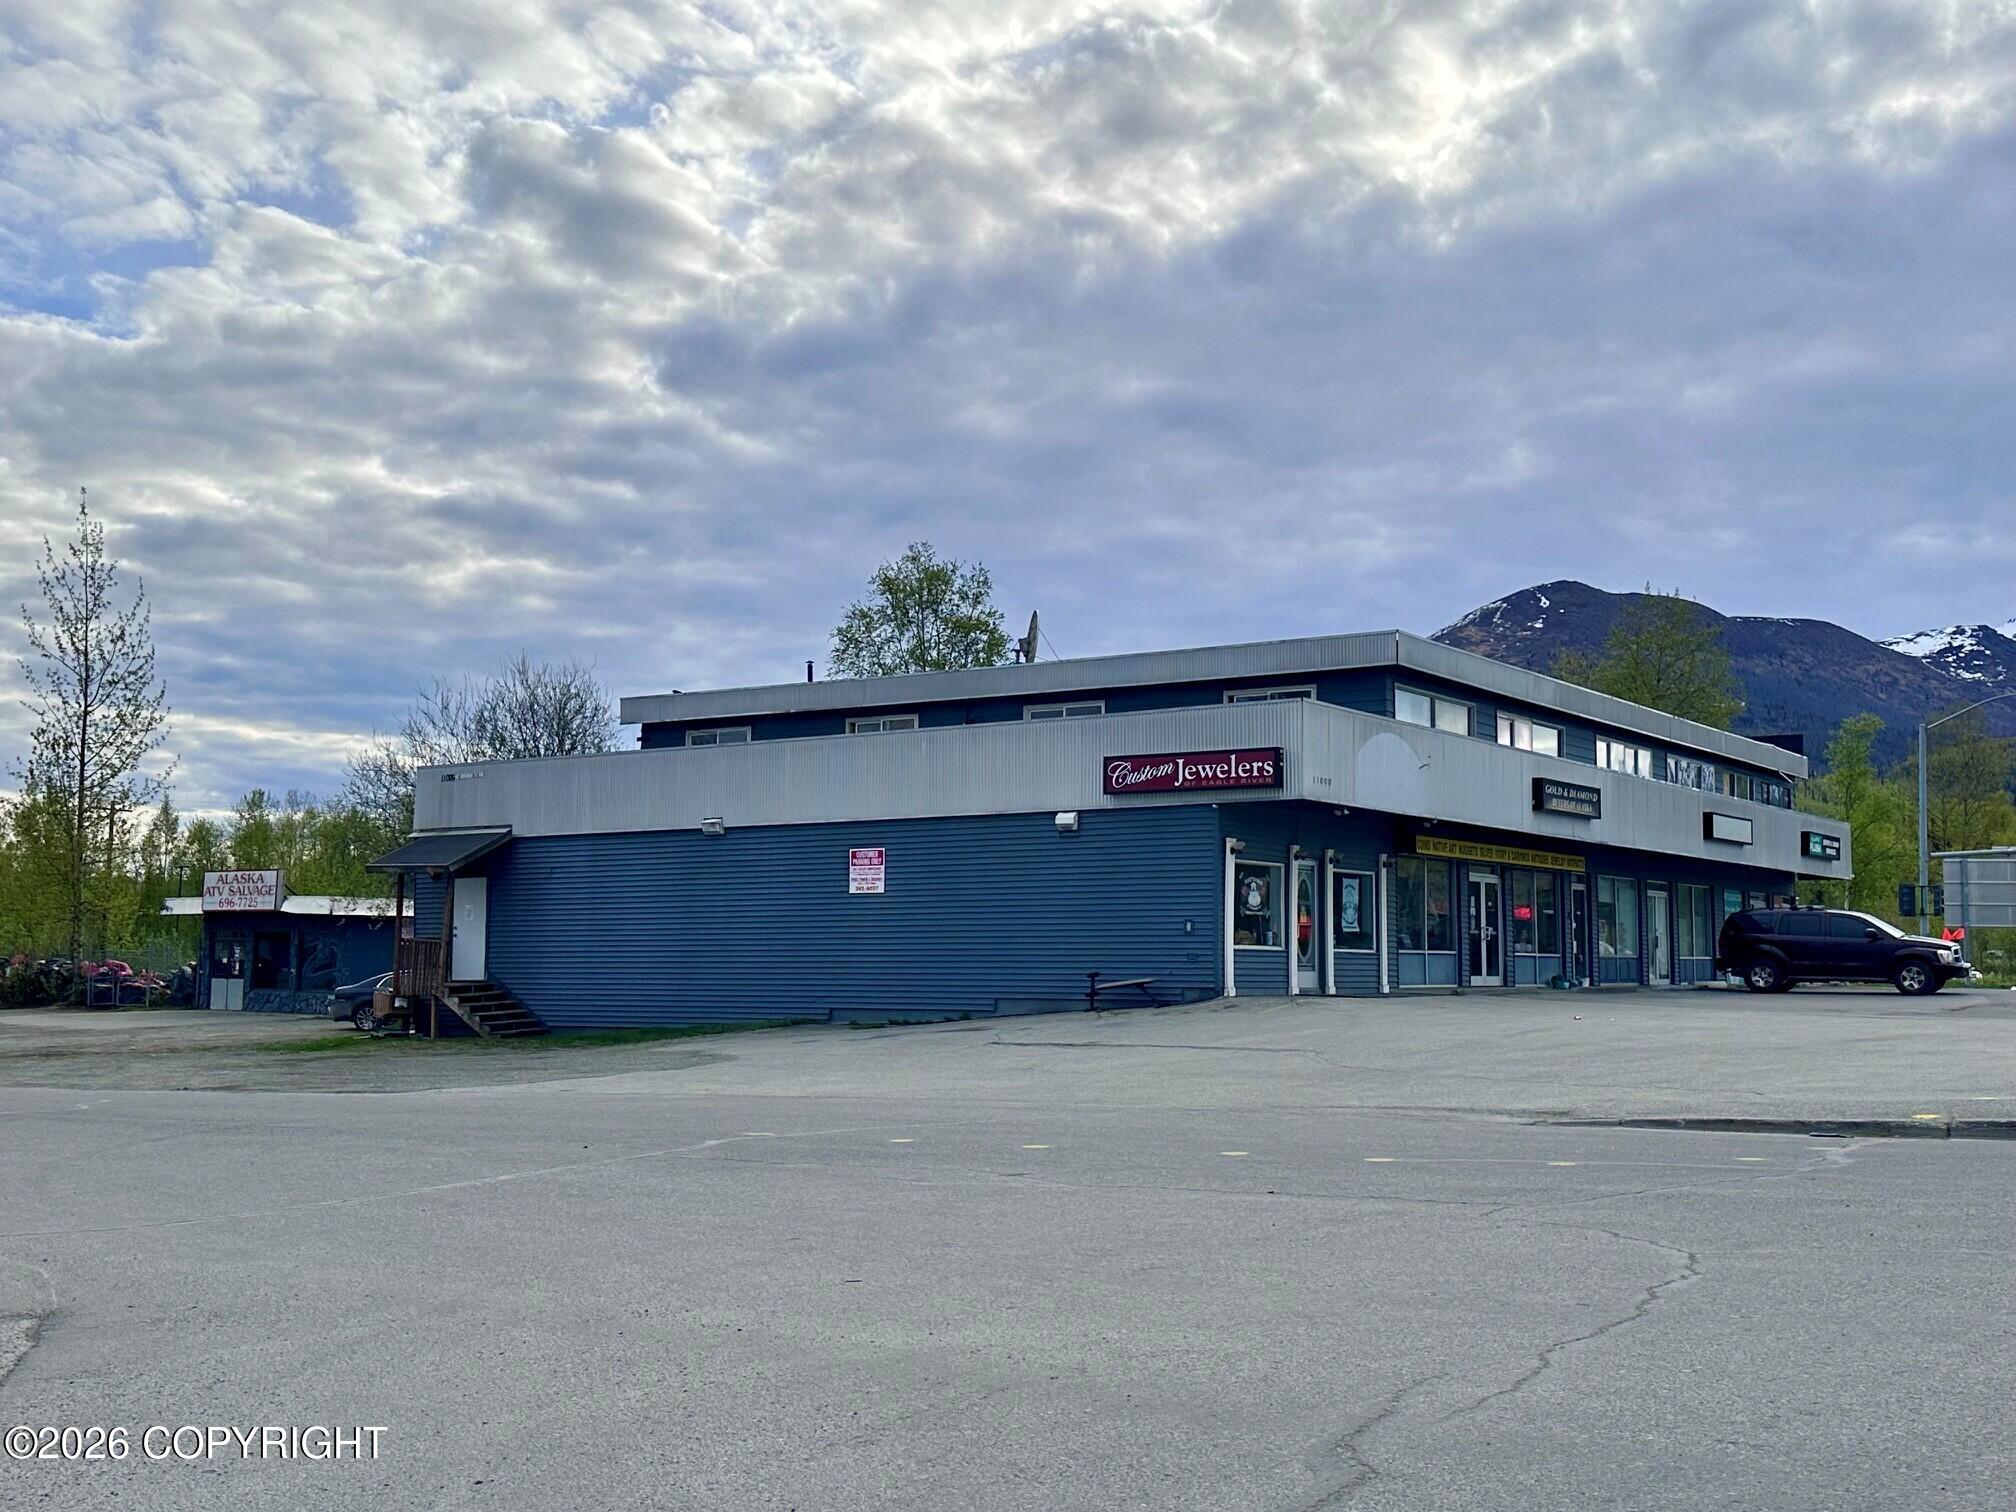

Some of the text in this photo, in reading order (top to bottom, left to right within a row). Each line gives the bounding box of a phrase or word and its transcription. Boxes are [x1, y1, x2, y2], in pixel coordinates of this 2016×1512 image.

[1107, 754, 1274, 788] Custom Jewelers
[1545, 784, 1598, 802] GOLD & DIAMOND
[216, 873, 264, 885] ALASKA
[204, 885, 275, 897] ATV SALVAGE
[218, 897, 258, 908] 696-7725
